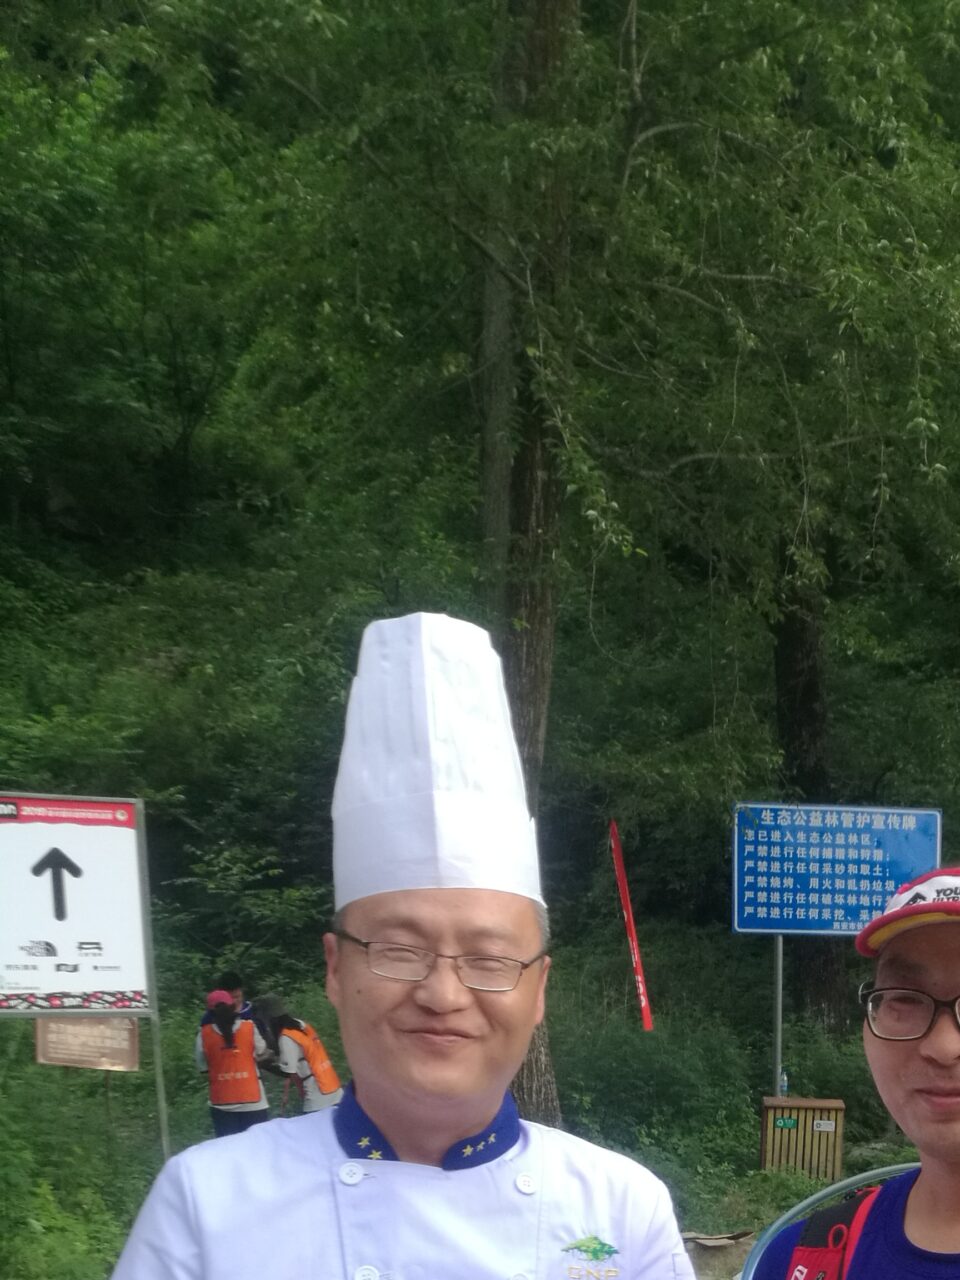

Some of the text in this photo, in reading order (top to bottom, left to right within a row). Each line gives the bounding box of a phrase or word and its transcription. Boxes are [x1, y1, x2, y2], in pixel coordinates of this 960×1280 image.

[761, 811, 917, 831] 生态公益林管护宣传牌
[833, 921, 869, 931] 西安市长
